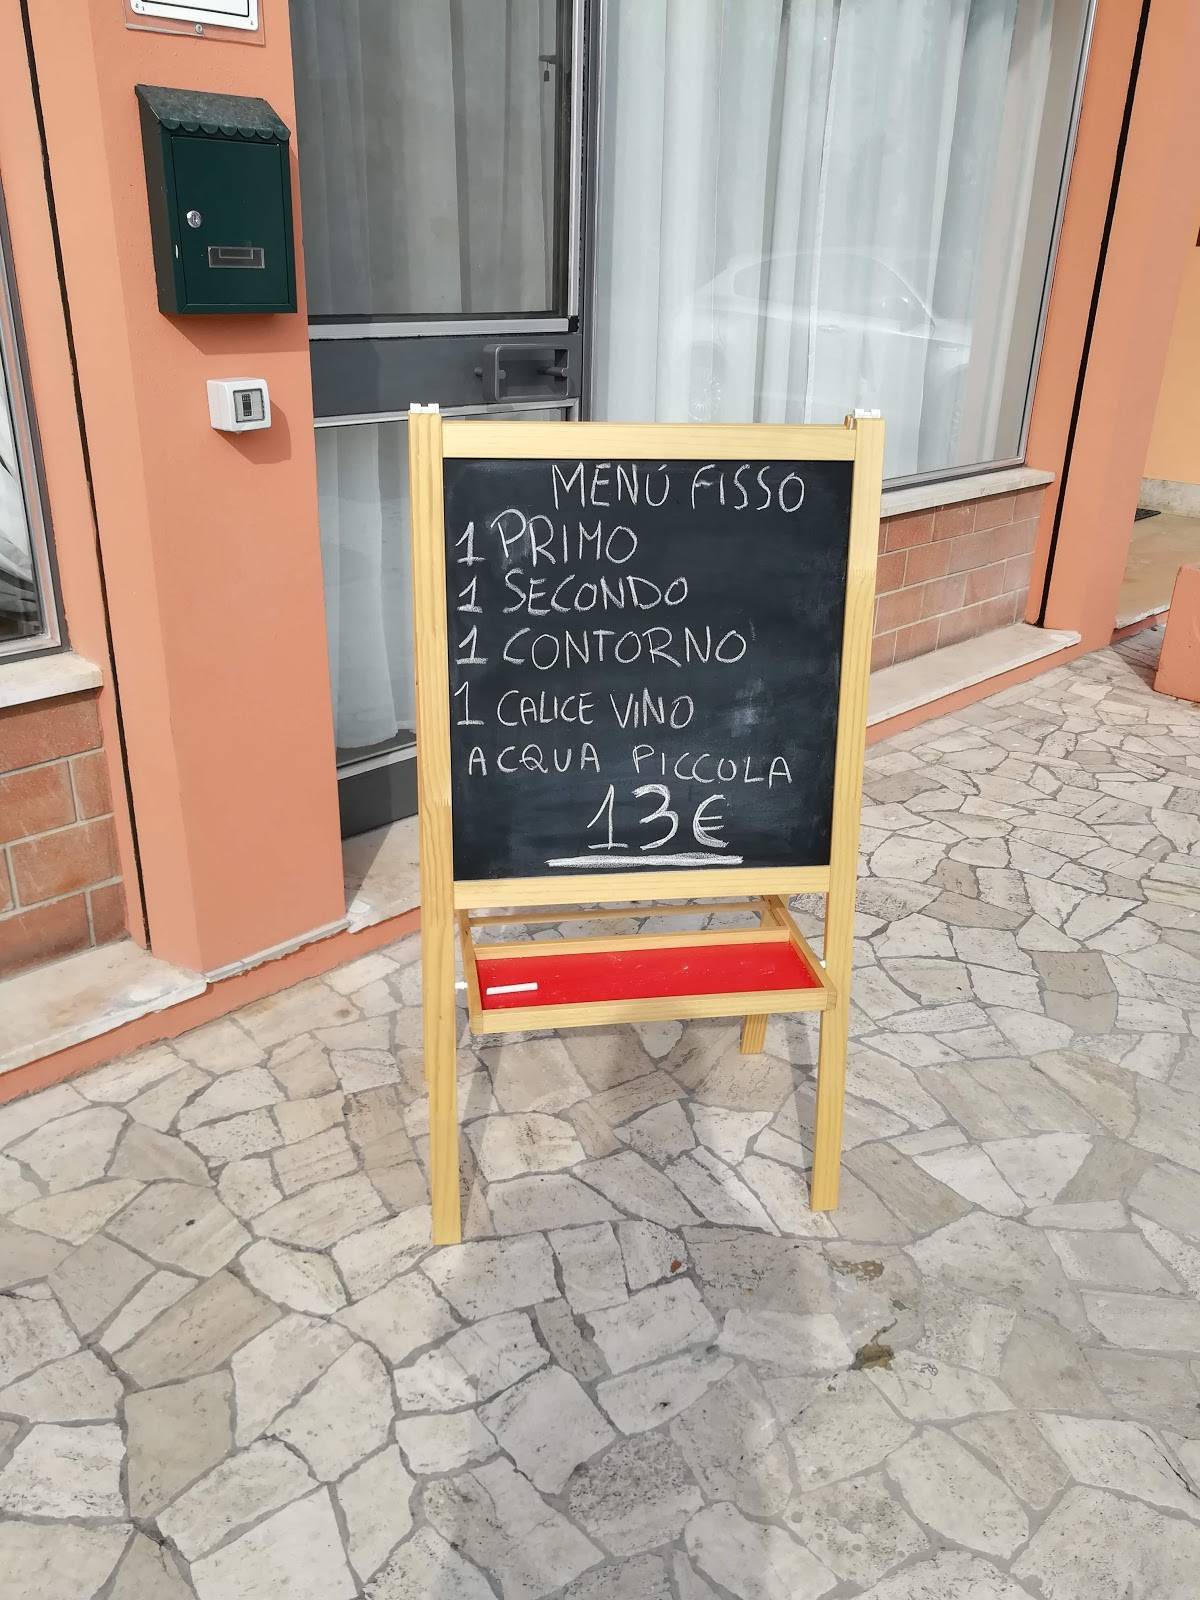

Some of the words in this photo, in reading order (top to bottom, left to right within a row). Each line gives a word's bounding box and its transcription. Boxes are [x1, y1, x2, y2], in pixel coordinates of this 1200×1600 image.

[691, 463, 805, 513] FISSO
[455, 521, 486, 566] 1
[490, 508, 638, 567] PRIMO
[456, 575, 484, 613] 1
[502, 568, 689, 616] SECONDO
[456, 625, 488, 665] 1
[502, 626, 747, 670] CONTORNO
[454, 681, 485, 726] 1
[496, 690, 595, 727] CALICE
[609, 688, 695, 729] VINO
[468, 742, 601, 776] ACQUA
[632, 744, 793, 788] PICCOLA
[586, 783, 730, 851] 13€
